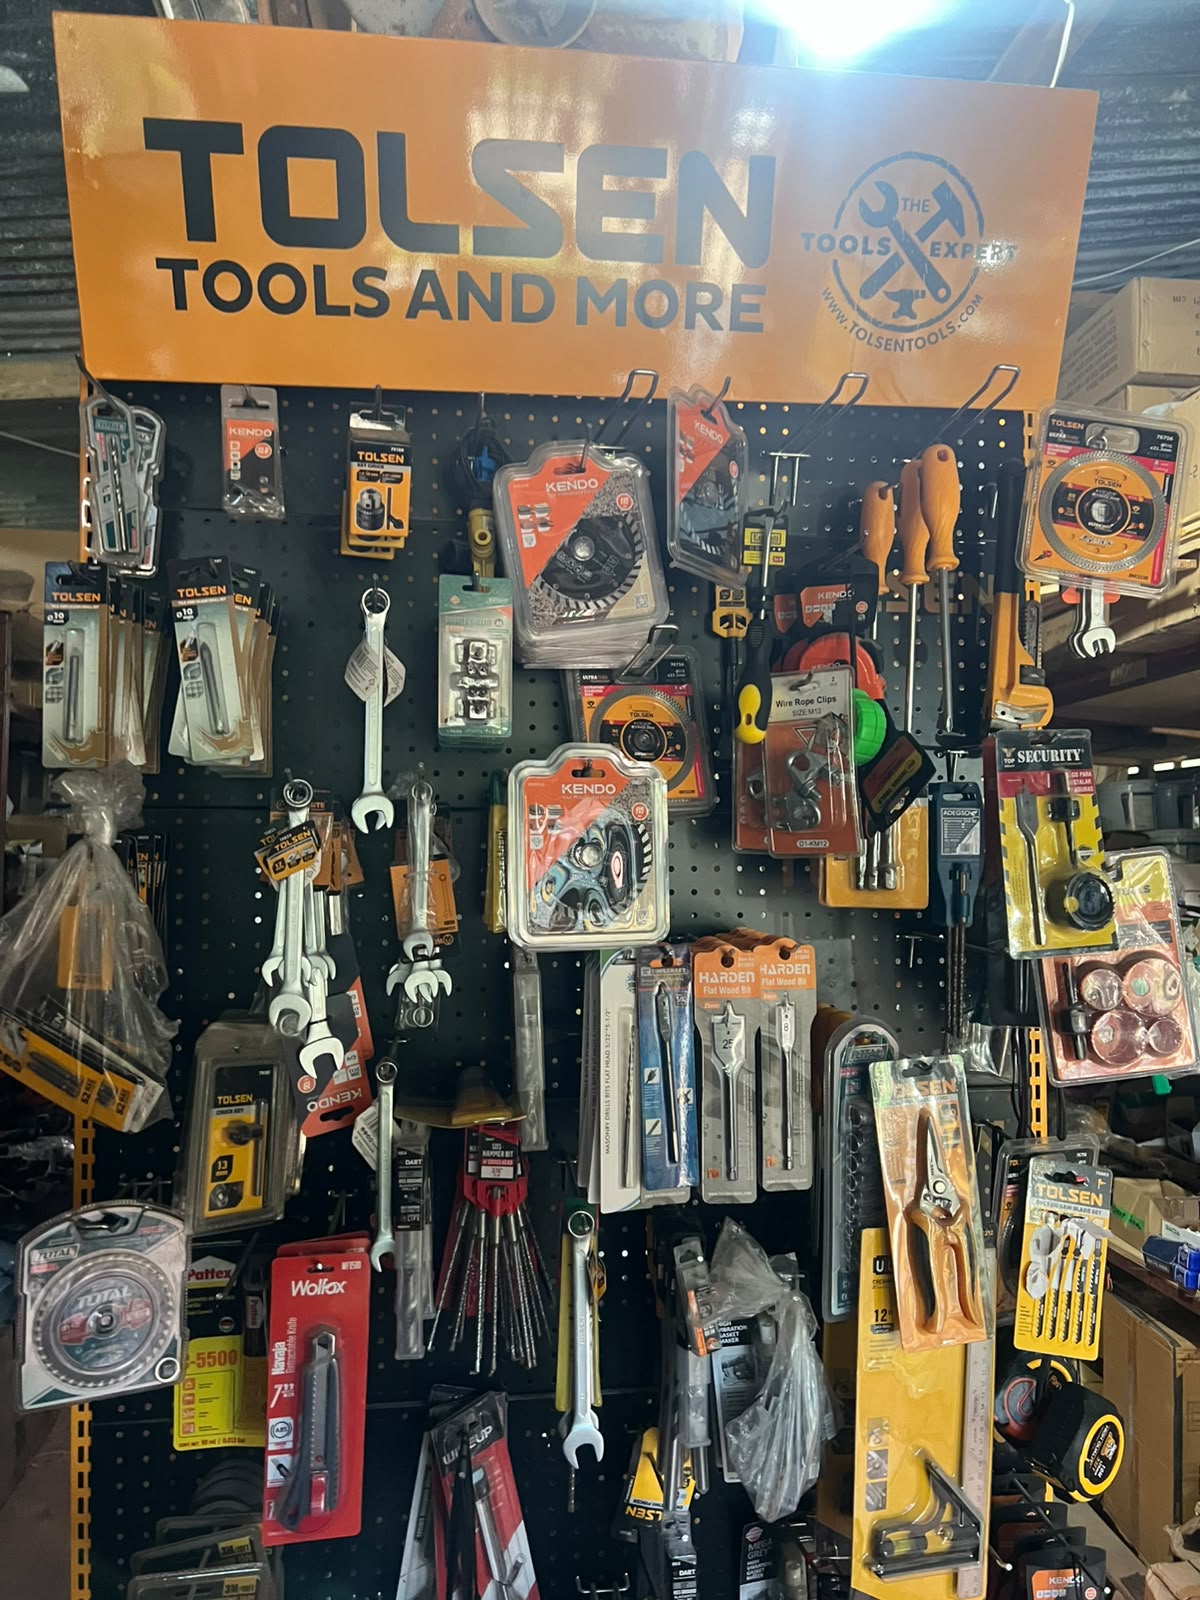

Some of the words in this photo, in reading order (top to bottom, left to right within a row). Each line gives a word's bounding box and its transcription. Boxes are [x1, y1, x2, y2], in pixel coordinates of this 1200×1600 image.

[143, 117, 777, 269] TOLSEN
[901, 197, 931, 214] THE
[801, 232, 892, 256] TOOLS
[929, 240, 1018, 263] EXPERT
[155, 257, 390, 318] TOOLS
[405, 269, 555, 323] AND
[576, 276, 766, 333] MORE
[822, 286, 984, 352] WWW.TOLSENTOOLS.COM
[1051, 418, 1085, 430] TOLSEN
[229, 428, 272, 437] KENDO
[693, 419, 724, 445] KENDO
[357, 451, 404, 464] TOLSEN
[545, 478, 598, 493] KENDO
[52, 592, 101, 602] TOLSEN
[177, 585, 227, 598] TOLSEN
[818, 590, 855, 600] KENDO
[776, 700, 793, 708] Wire
[794, 698, 815, 707] Rope
[816, 695, 837, 704] Clips
[629, 709, 654, 718] TOLSEN
[1017, 748, 1081, 763] SECURITY
[561, 783, 616, 795] KENDO
[273, 830, 312, 852] TOLSEN
[760, 963, 811, 975] HARDEN
[699, 971, 755, 983] HARDEN
[761, 978, 776, 986] Flat
[777, 977, 796, 985] Wood
[798, 977, 807, 985] Bit
[703, 986, 718, 995] Flat
[720, 985, 739, 994] Wood
[741, 985, 751, 994] Bit
[783, 1023, 789, 1032] 8
[722, 1039, 734, 1049] 25
[217, 1093, 253, 1105] TOLSEN
[307, 1088, 362, 1112] KENDO
[217, 1160, 228, 1170] 13
[1035, 1183, 1103, 1207] TOLSEN
[187, 1268, 232, 1280] Pattex
[291, 1278, 348, 1297] Wolfox
[77, 1287, 133, 1308] TOTAL
[287, 1317, 297, 1335] Knife
[271, 1341, 286, 1375] Navaja
[285, 1336, 297, 1374] Retractable
[625, 1506, 663, 1521] LSEN
[679, 1568, 697, 1576] DART
[1049, 1576, 1084, 1585] KENDO
